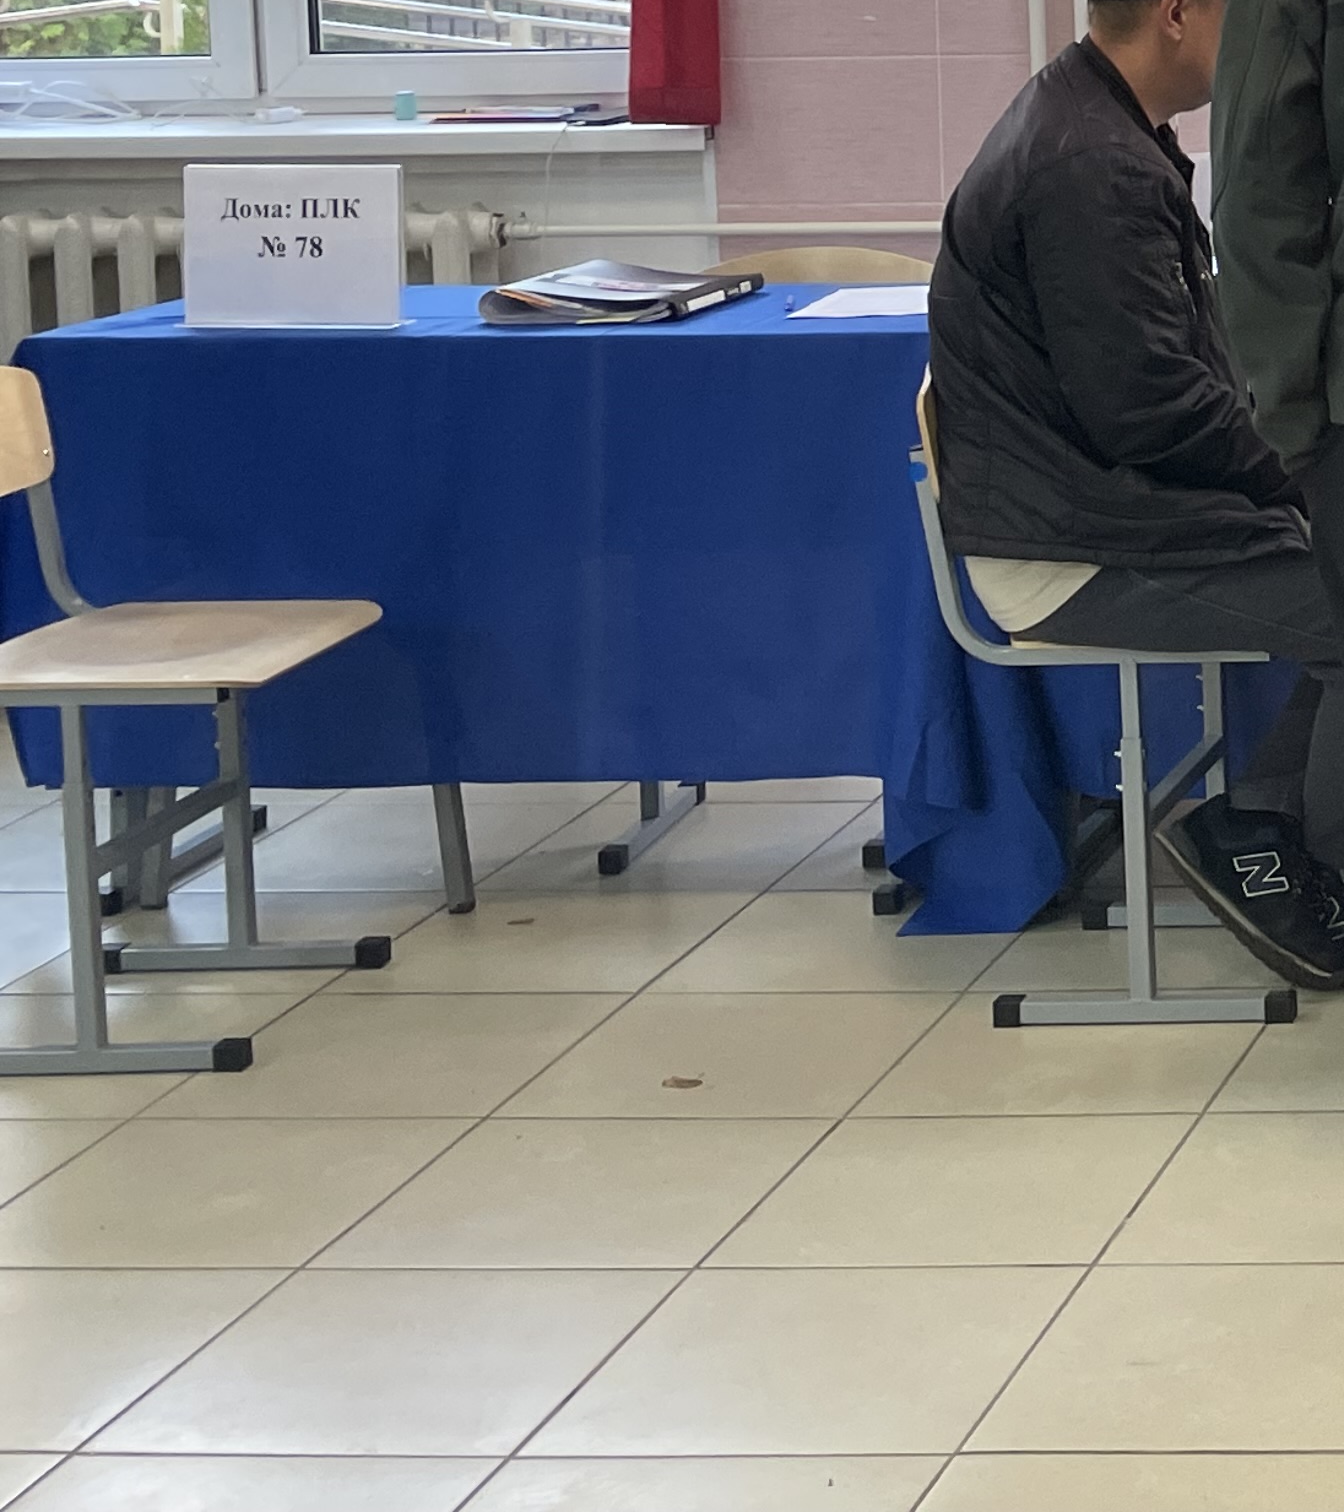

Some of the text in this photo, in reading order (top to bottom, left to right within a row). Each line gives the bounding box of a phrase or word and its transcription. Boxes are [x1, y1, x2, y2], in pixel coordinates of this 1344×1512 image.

[220, 198, 360, 222] Дома: ПЛК
[257, 235, 324, 259] № 78
[1232, 851, 1289, 897] N
